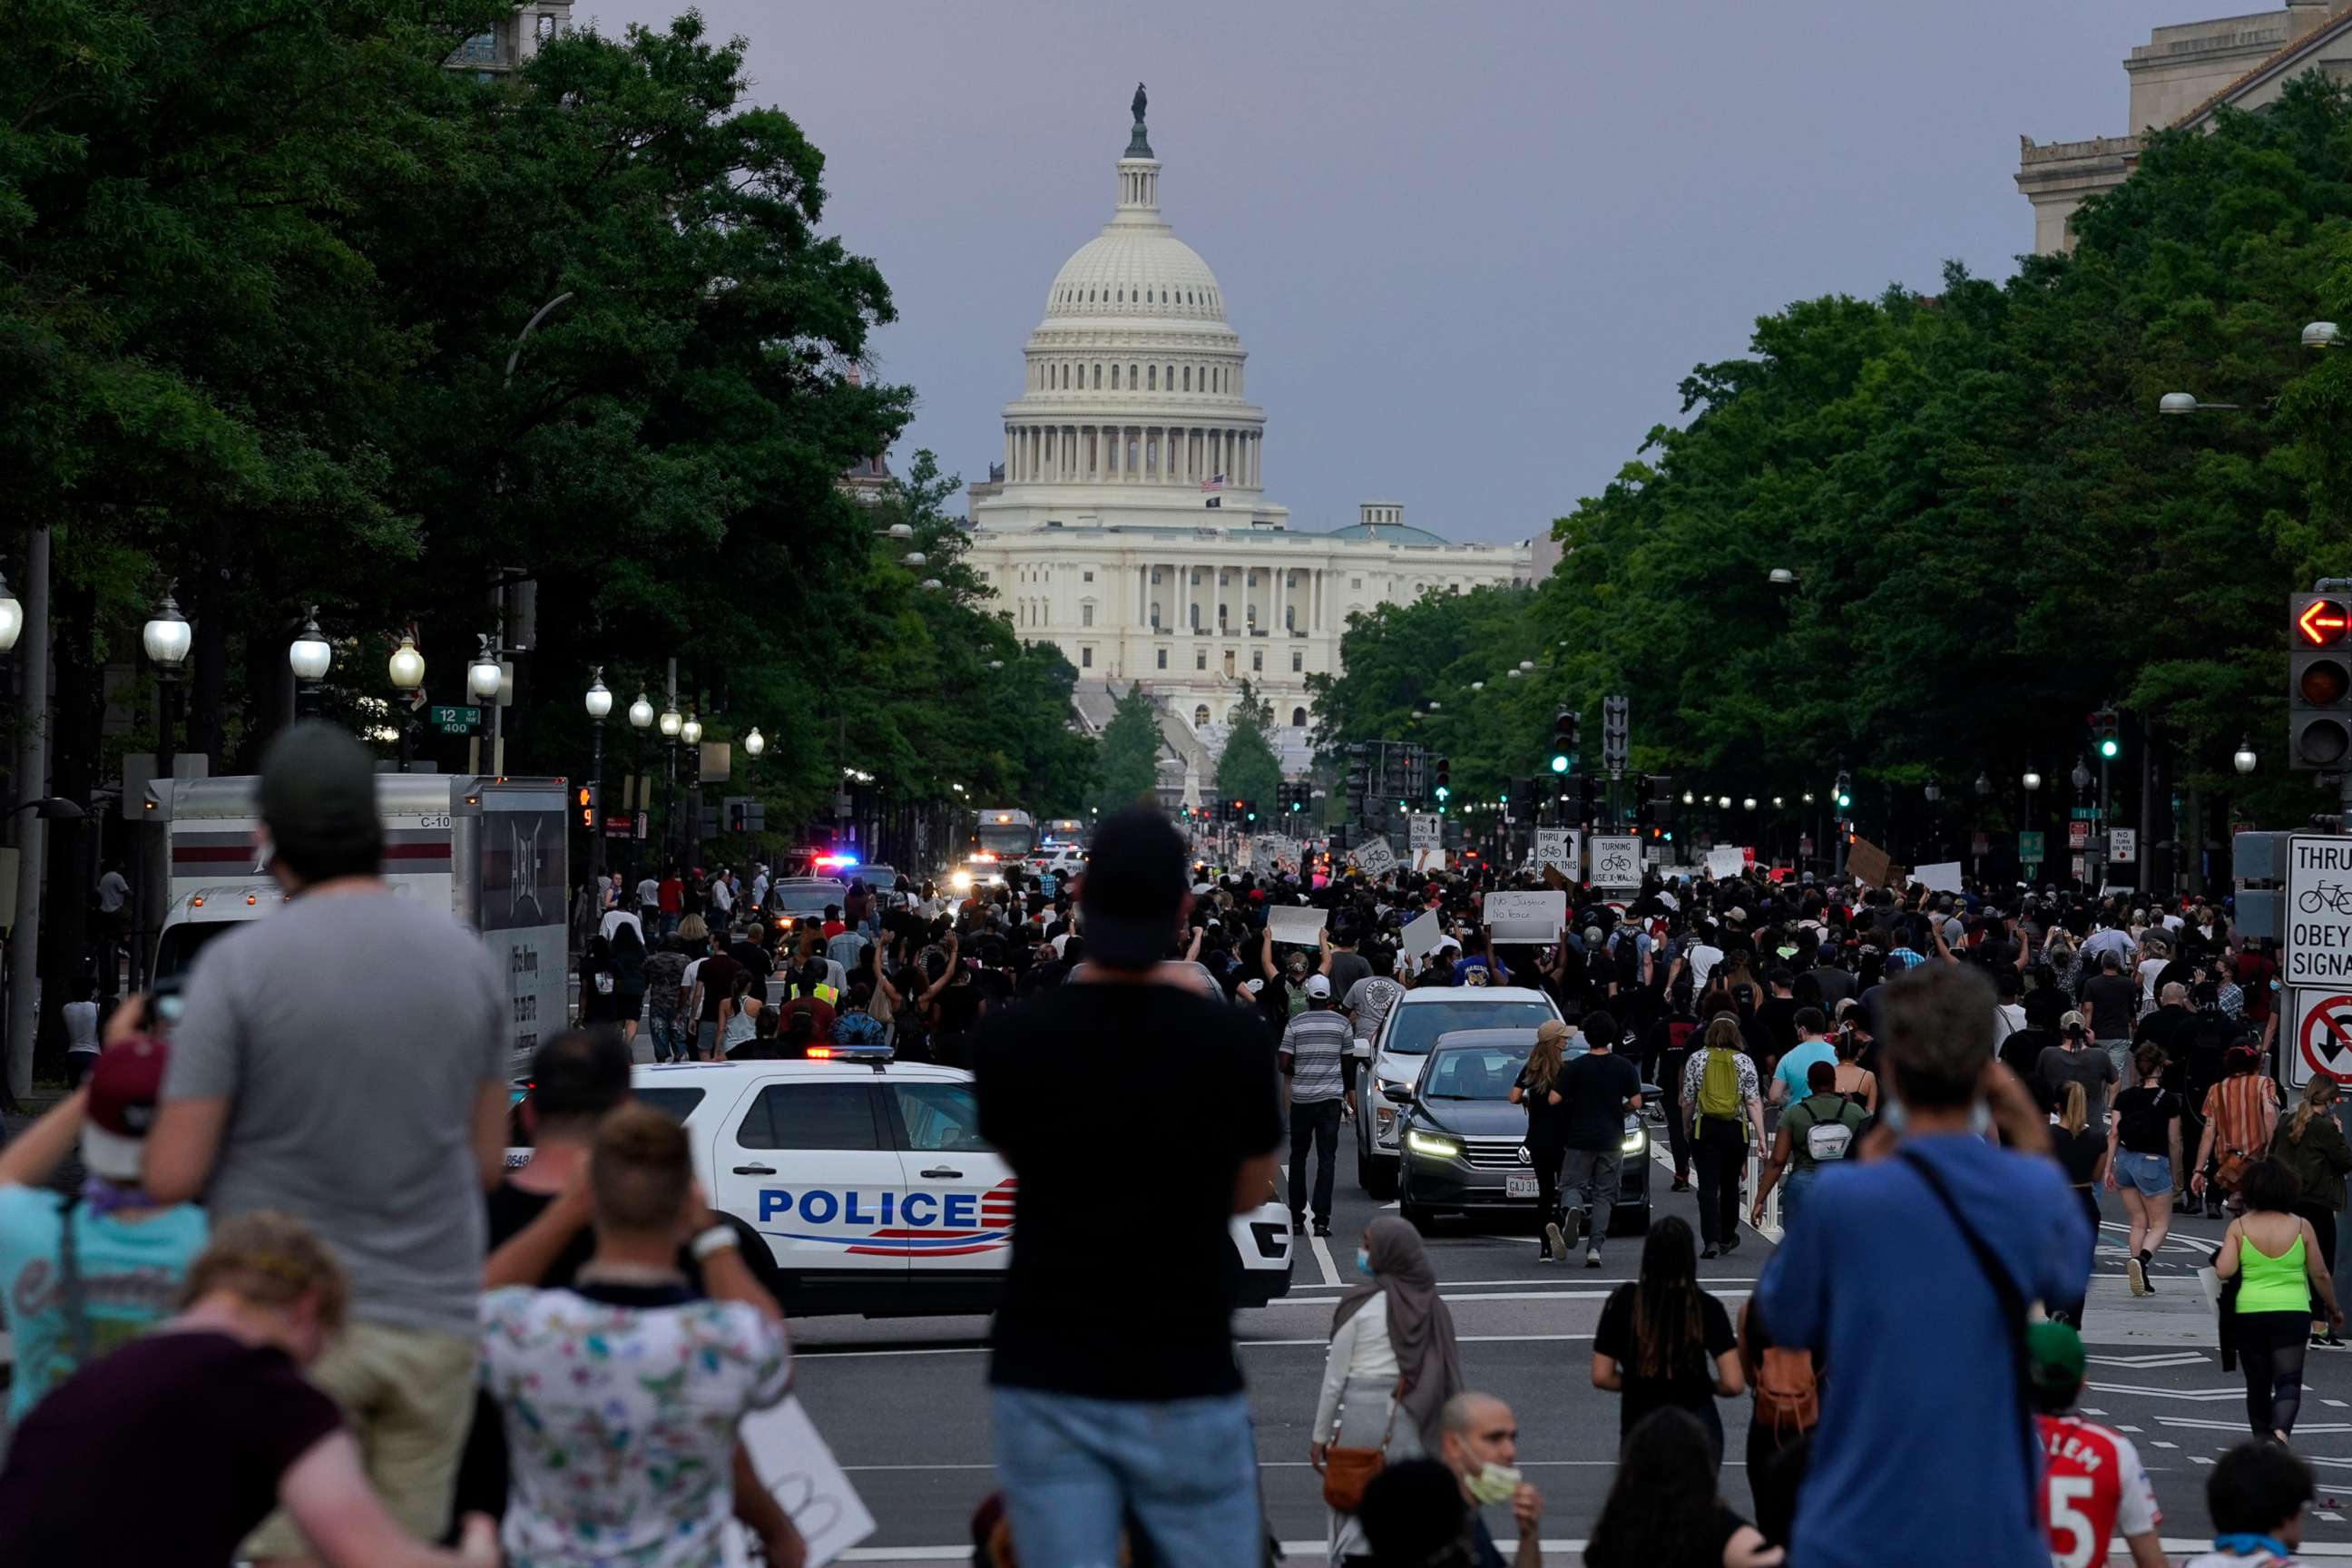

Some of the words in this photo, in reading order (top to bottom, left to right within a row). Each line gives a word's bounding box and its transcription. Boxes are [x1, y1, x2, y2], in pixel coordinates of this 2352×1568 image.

[439, 709, 456, 722] 12
[444, 723, 466, 733] 400
[583, 808, 592, 826] 9
[421, 818, 450, 828] C-10
[1540, 833, 1559, 842] THRU
[1602, 842, 1631, 851] TURNING
[1561, 860, 1577, 869] THIS
[2298, 847, 2352, 871] THRU
[1493, 897, 1506, 906] No
[1512, 895, 1546, 906] Justice
[1493, 908, 1504, 918] No
[1508, 909, 1532, 919] Peace
[2294, 924, 2351, 947] OBEY
[759, 1190, 977, 1228] POLICE
